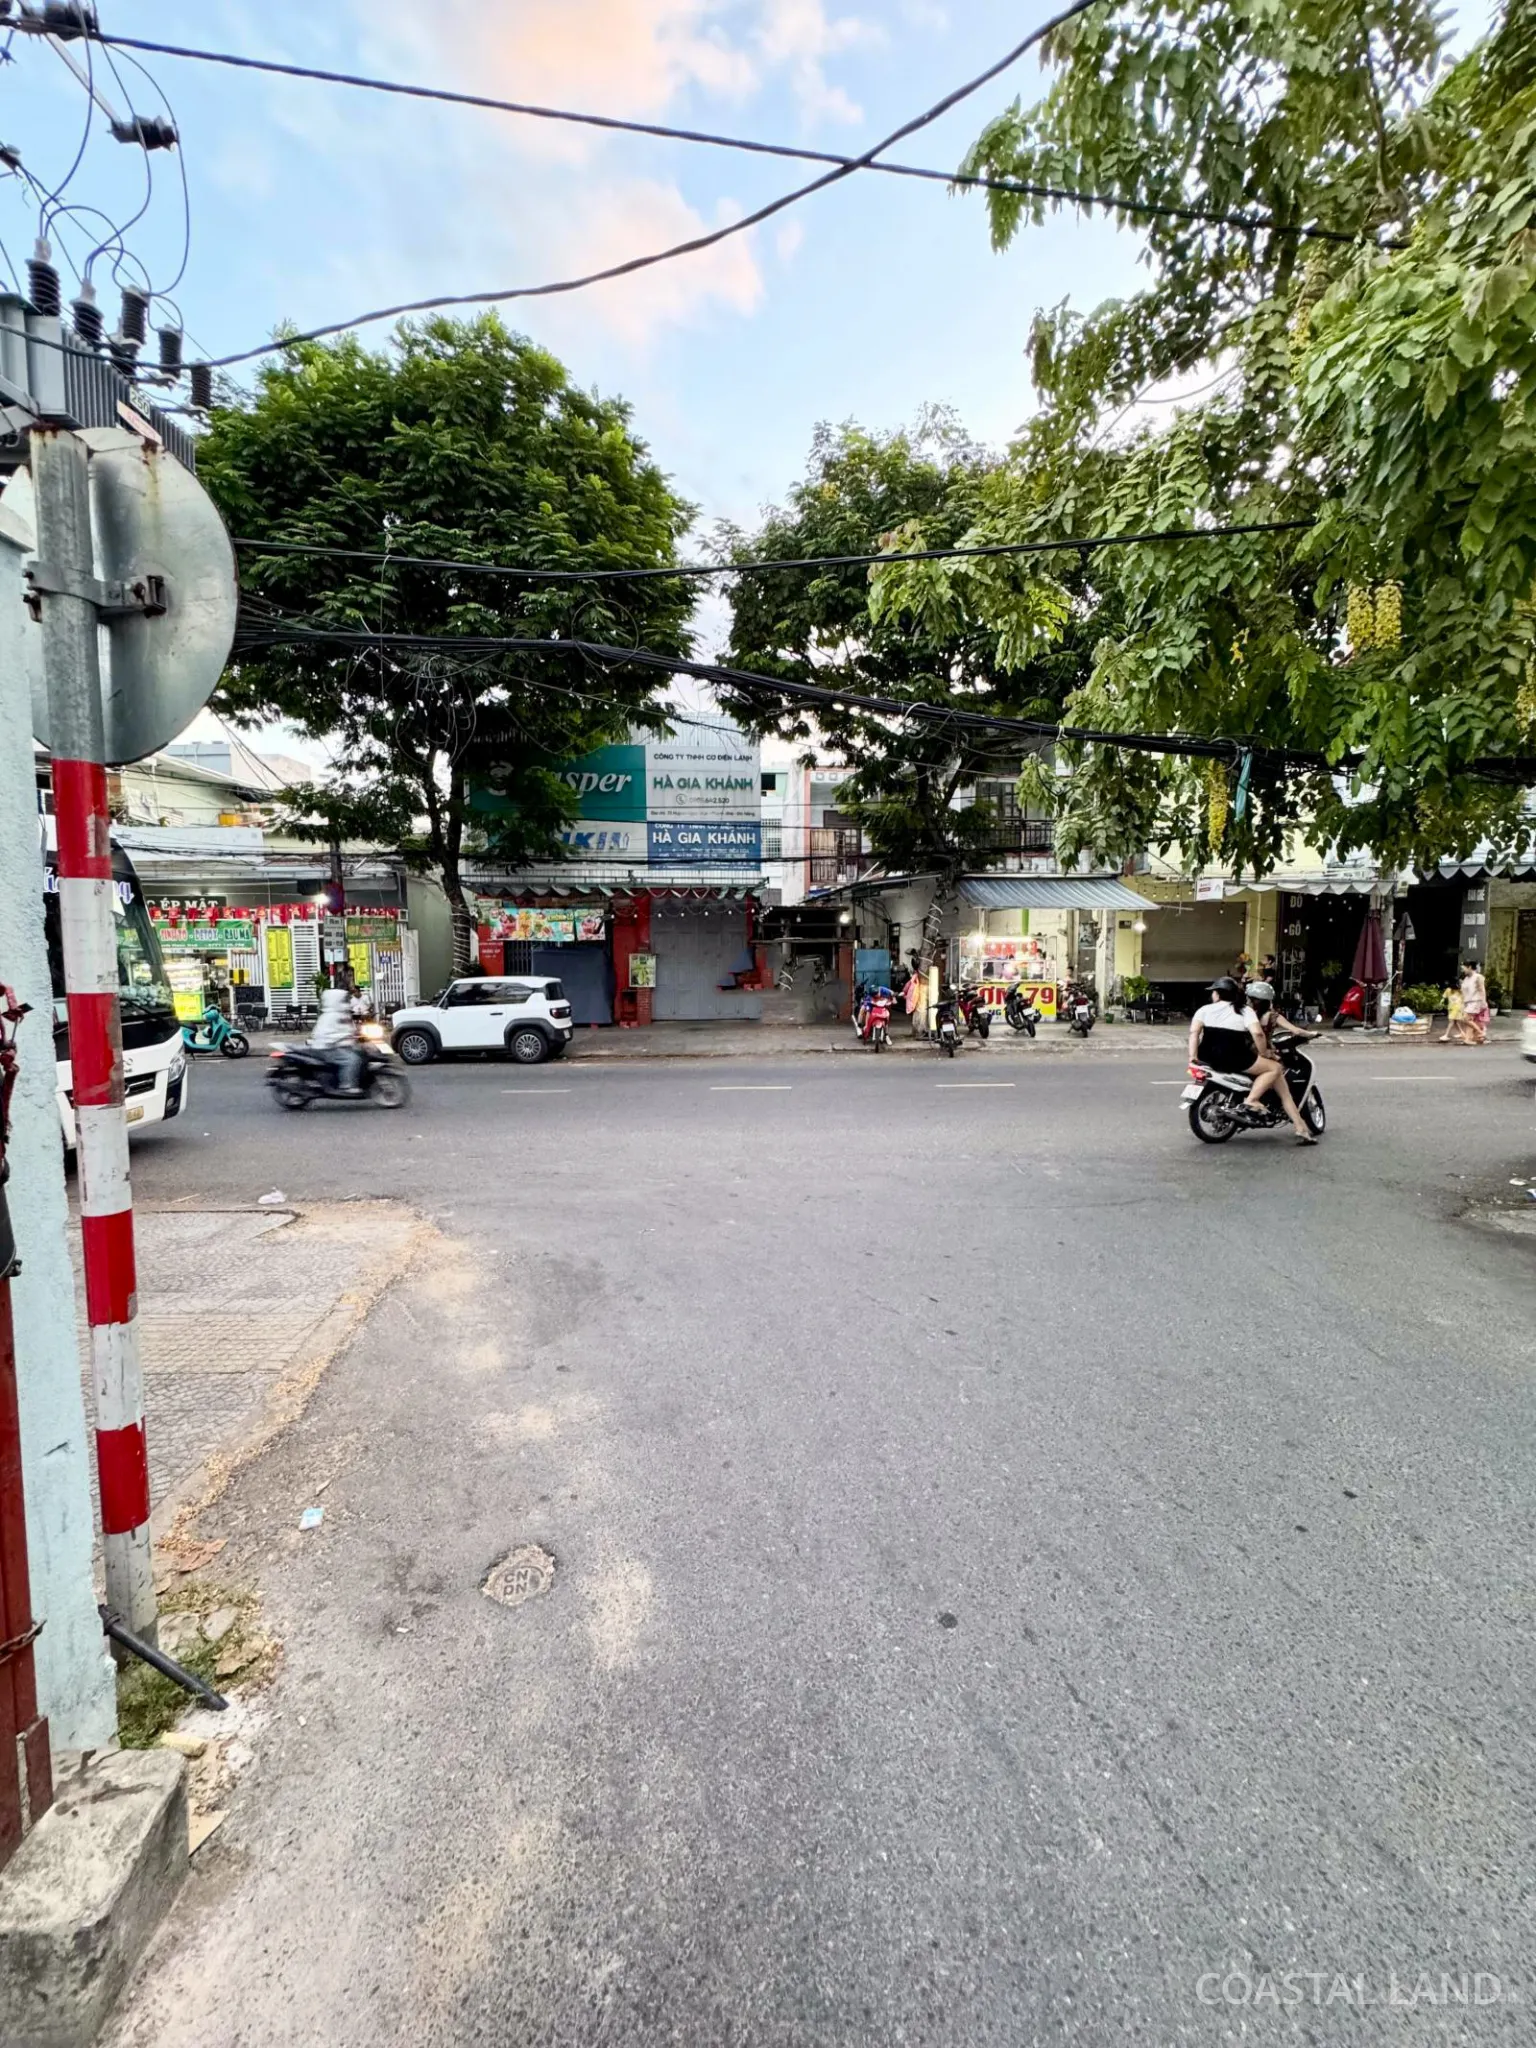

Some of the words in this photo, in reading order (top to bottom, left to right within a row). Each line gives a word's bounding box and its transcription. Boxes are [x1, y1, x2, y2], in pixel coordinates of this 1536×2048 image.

[131, 391, 149, 415] 250
[653, 774, 674, 789] HÀ
[677, 777, 700, 789] GIA
[705, 775, 753, 790] KHÁNH
[653, 829, 671, 843] HÀ
[678, 832, 701, 843] GIA
[708, 830, 755, 844] KHÁNH
[1025, 986, 1054, 1005] 79
